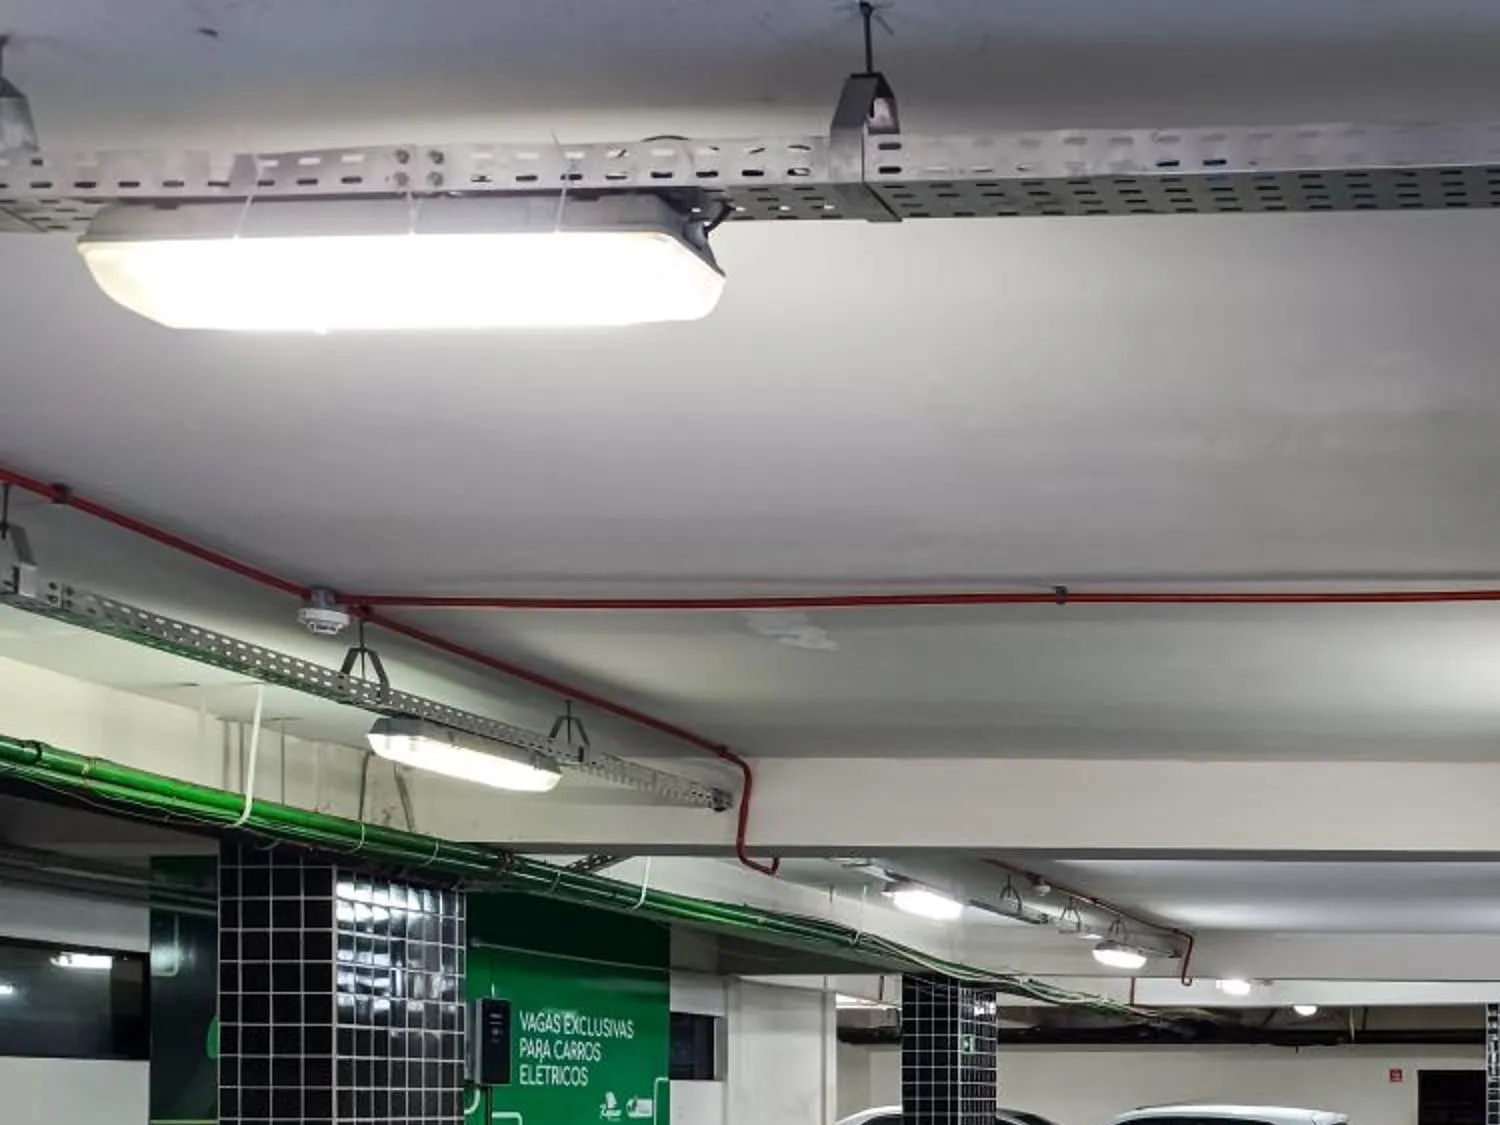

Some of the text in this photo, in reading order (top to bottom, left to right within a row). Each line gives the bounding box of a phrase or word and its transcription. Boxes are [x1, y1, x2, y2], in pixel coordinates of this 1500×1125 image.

[519, 1010, 635, 1039] VAGAS EXCLUSIVAS
[519, 1037, 602, 1062] PARA CARROS
